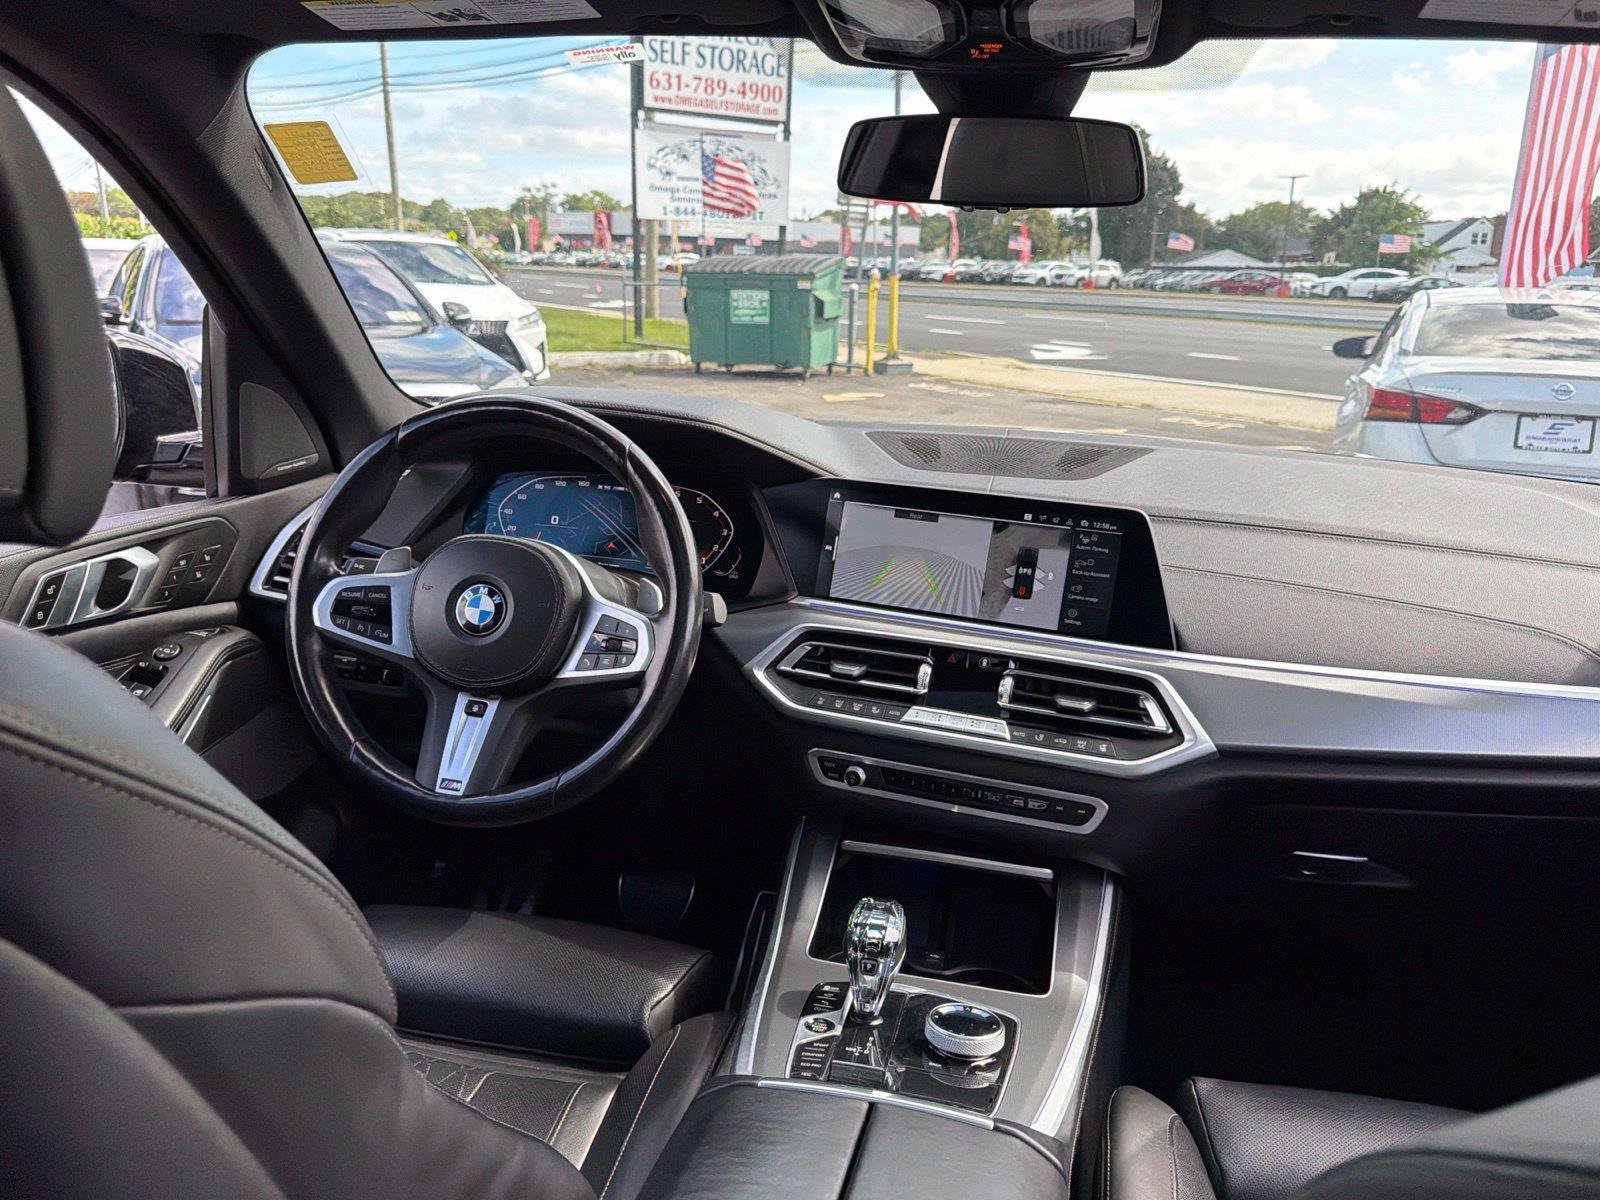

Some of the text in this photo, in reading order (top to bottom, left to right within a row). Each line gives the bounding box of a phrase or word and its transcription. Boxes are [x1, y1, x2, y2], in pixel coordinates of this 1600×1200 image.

[648, 38, 786, 78] SELF STORAGE
[648, 71, 784, 104] 631-789-4900
[551, 515, 559, 525] 0
[713, 510, 720, 518] 4
[506, 524, 517, 532] 20
[463, 586, 502, 604] BMW
